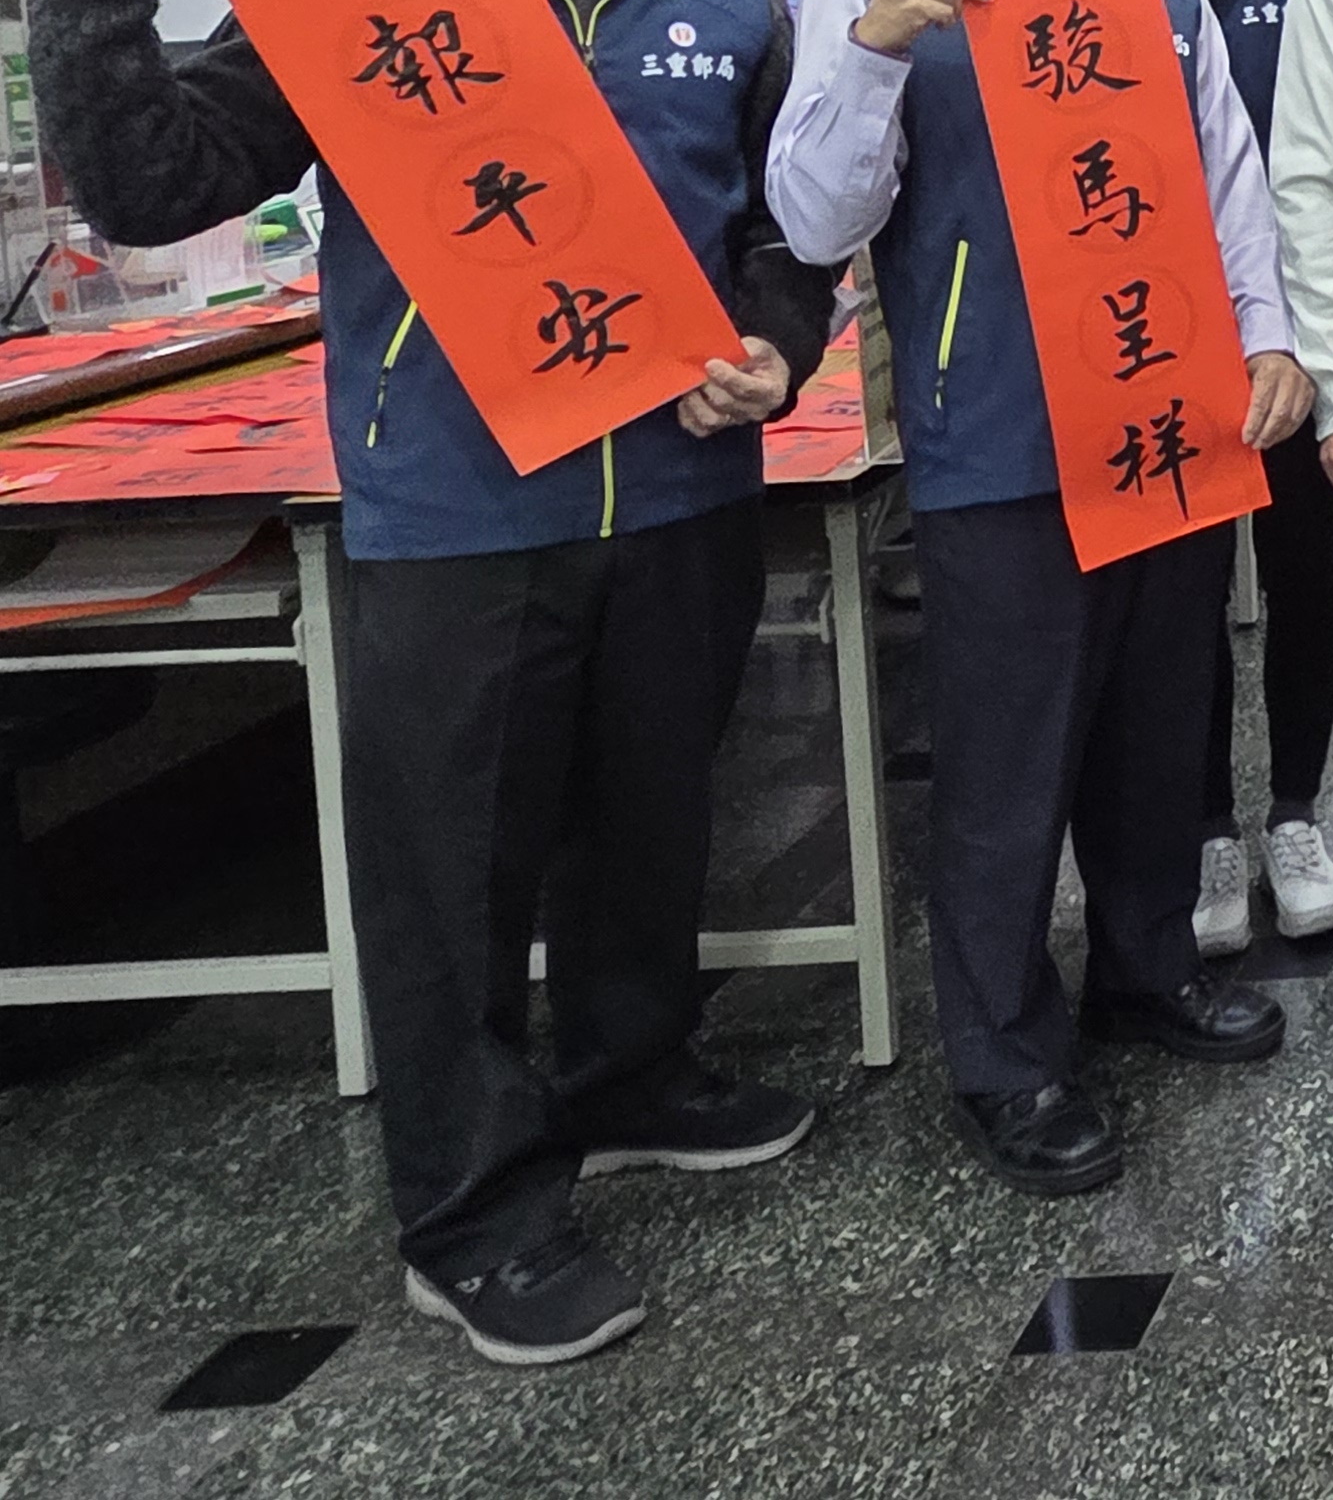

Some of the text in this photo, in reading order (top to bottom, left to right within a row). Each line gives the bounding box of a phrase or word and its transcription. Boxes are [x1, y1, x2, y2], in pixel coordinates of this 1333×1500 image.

[641, 52, 735, 81] 三重郵局
[1022, 1, 1200, 521] 駿馬呈祥
